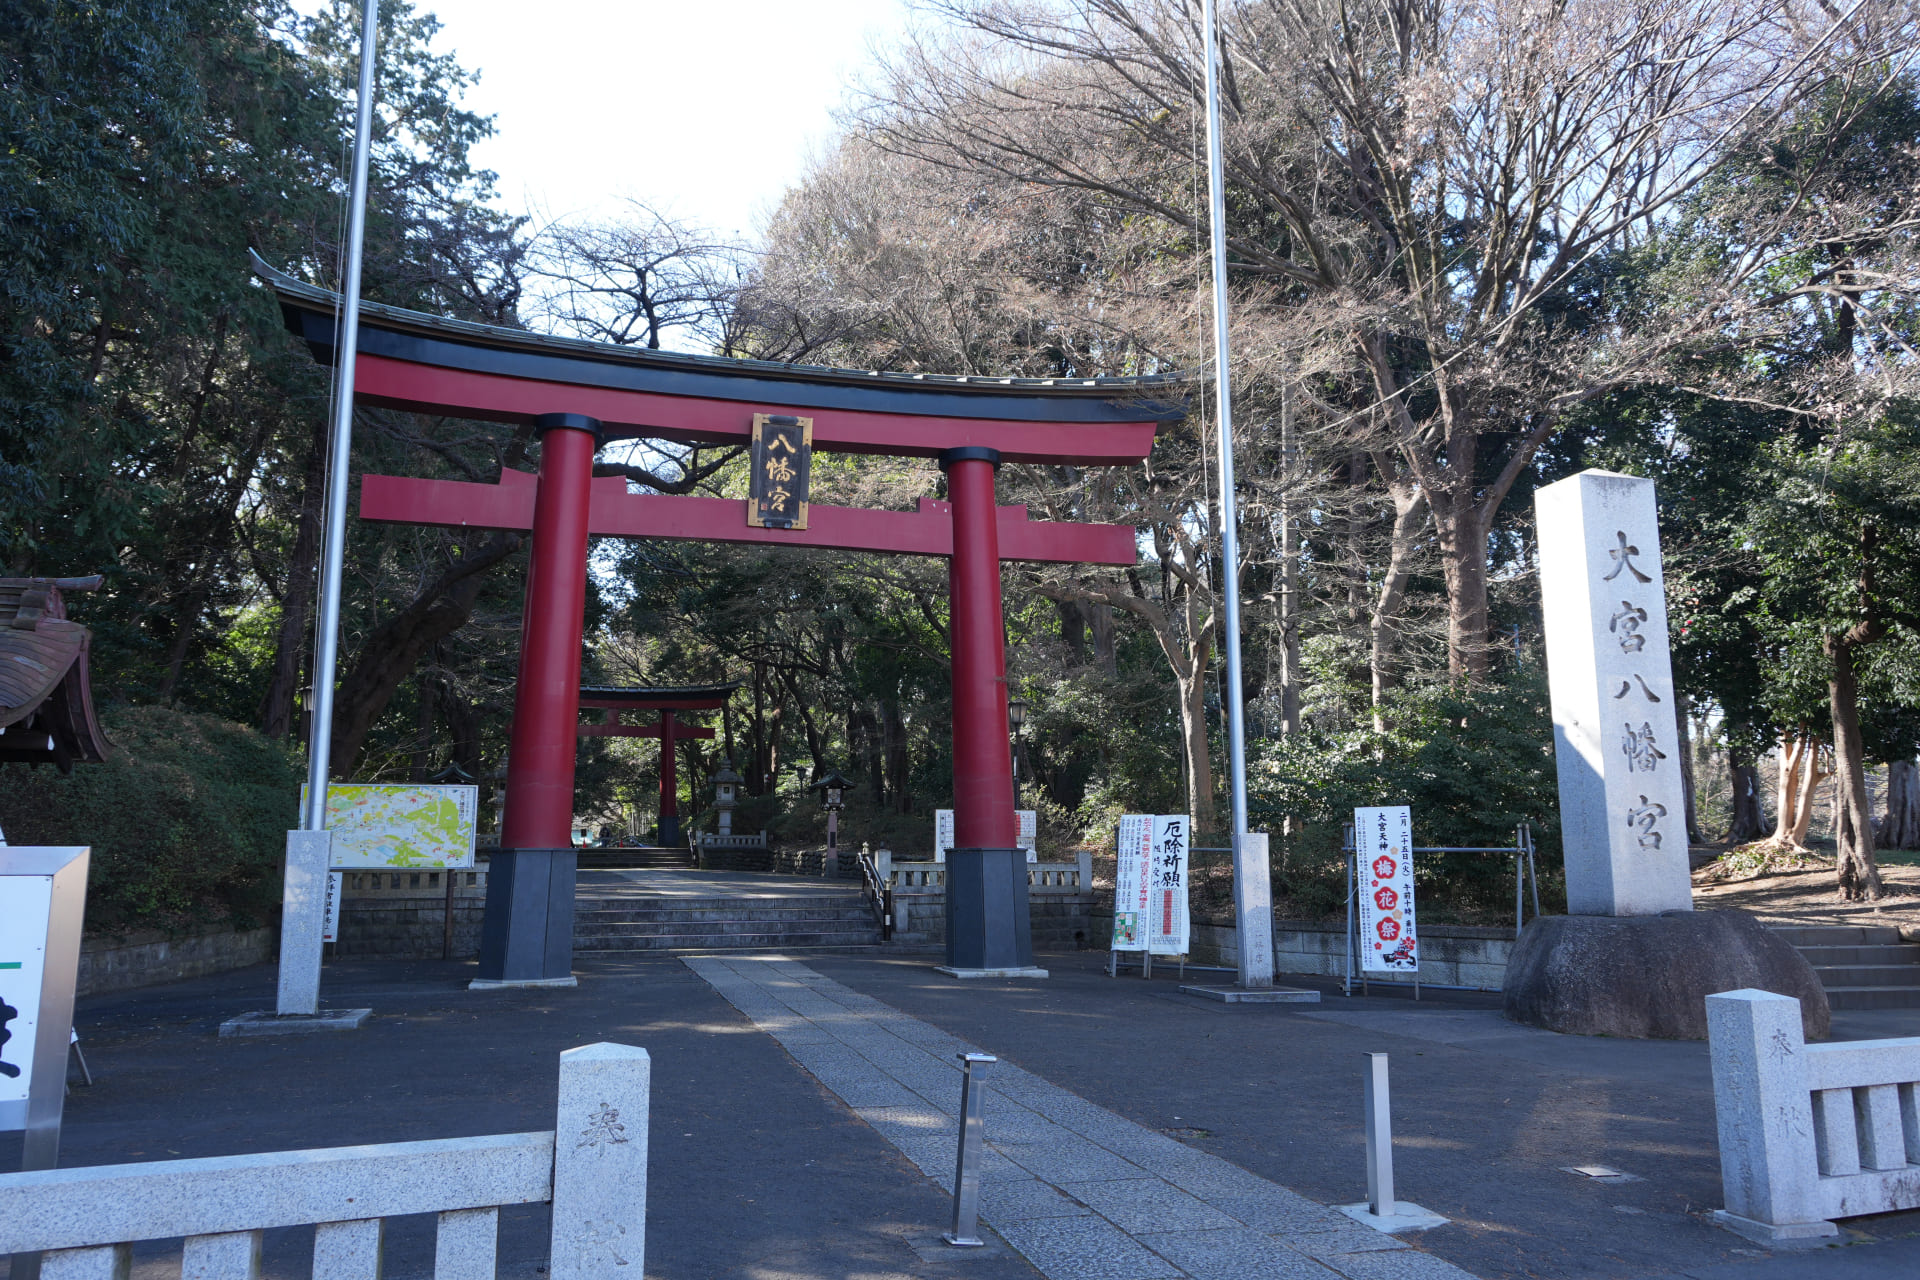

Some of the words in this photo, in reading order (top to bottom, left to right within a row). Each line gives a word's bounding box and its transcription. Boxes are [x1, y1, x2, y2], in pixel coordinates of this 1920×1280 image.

[765, 433, 797, 512] 八幡宮
[1602, 529, 1668, 852] 大宮八幡宮
[1161, 820, 1184, 887] 厄除祈願
[1377, 812, 1389, 851] 大宮天神
[1376, 860, 1397, 938] 梅花祭
